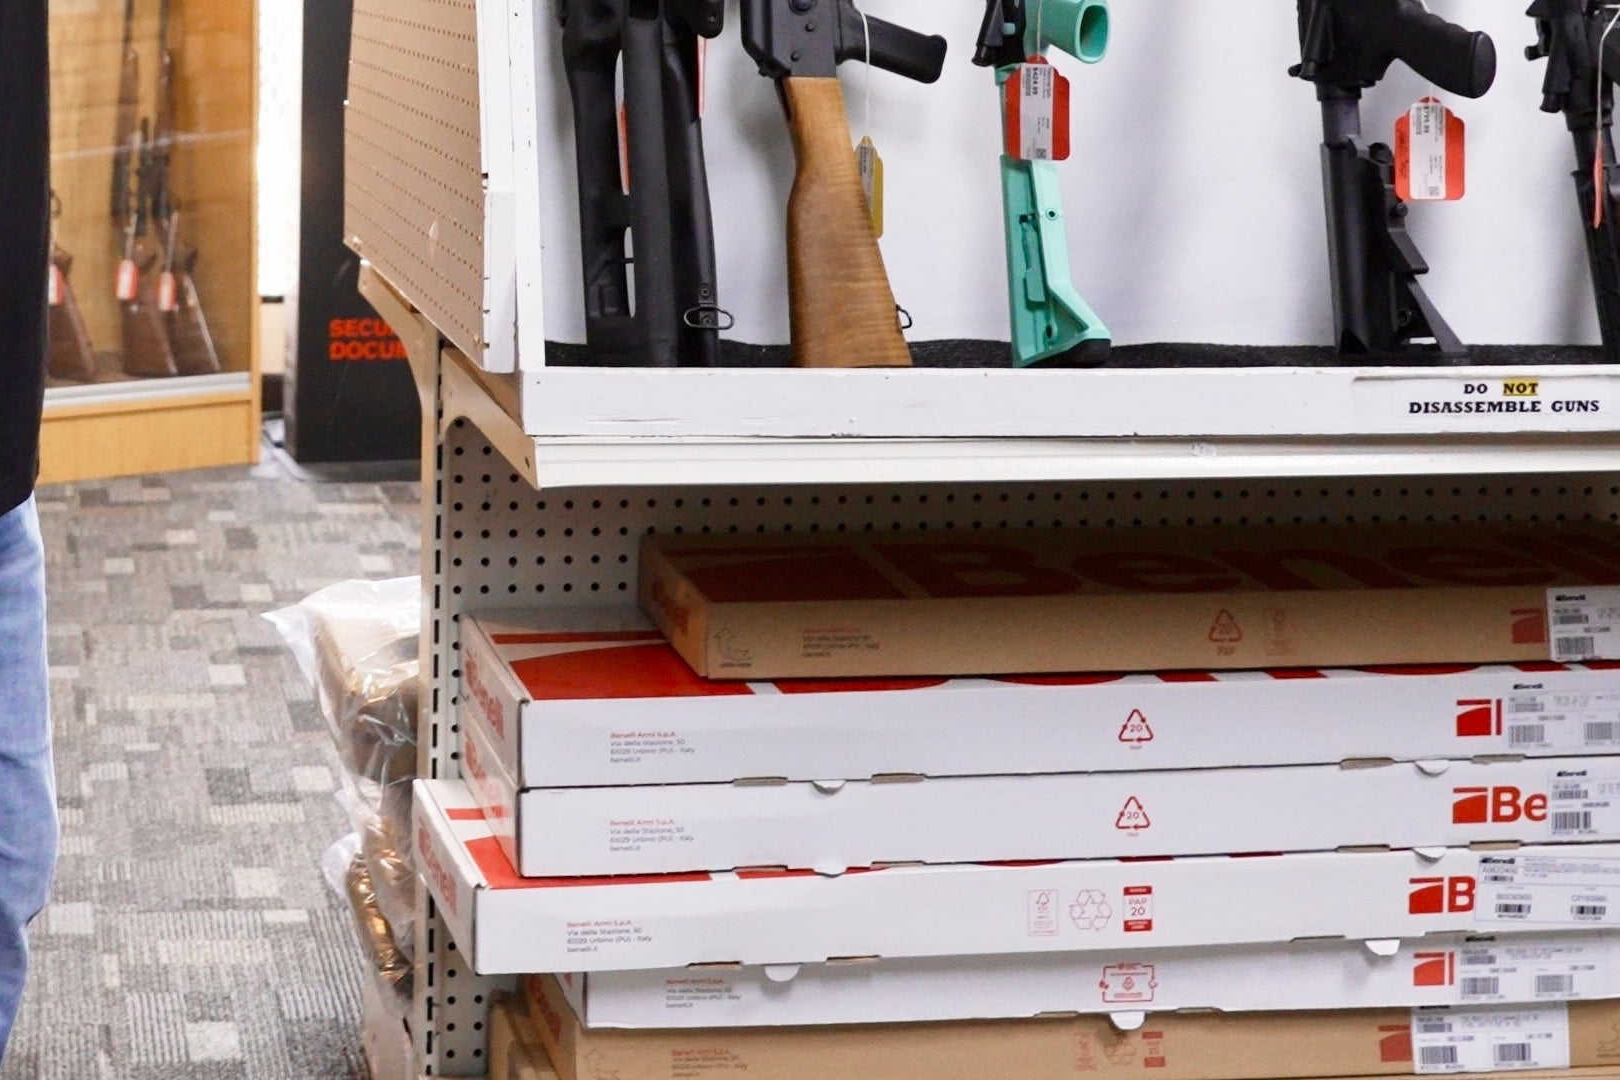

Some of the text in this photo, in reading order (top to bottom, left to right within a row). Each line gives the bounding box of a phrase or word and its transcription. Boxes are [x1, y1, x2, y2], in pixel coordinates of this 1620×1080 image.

[329, 317, 393, 337] SECU
[1464, 383, 1539, 395] DO NOT
[1409, 399, 1600, 414] DISASSEMBLE GUNS
[1130, 724, 1143, 733] 20
[1127, 811, 1140, 820] 20
[1130, 897, 1147, 905] PAP
[1131, 906, 1146, 916] 20
